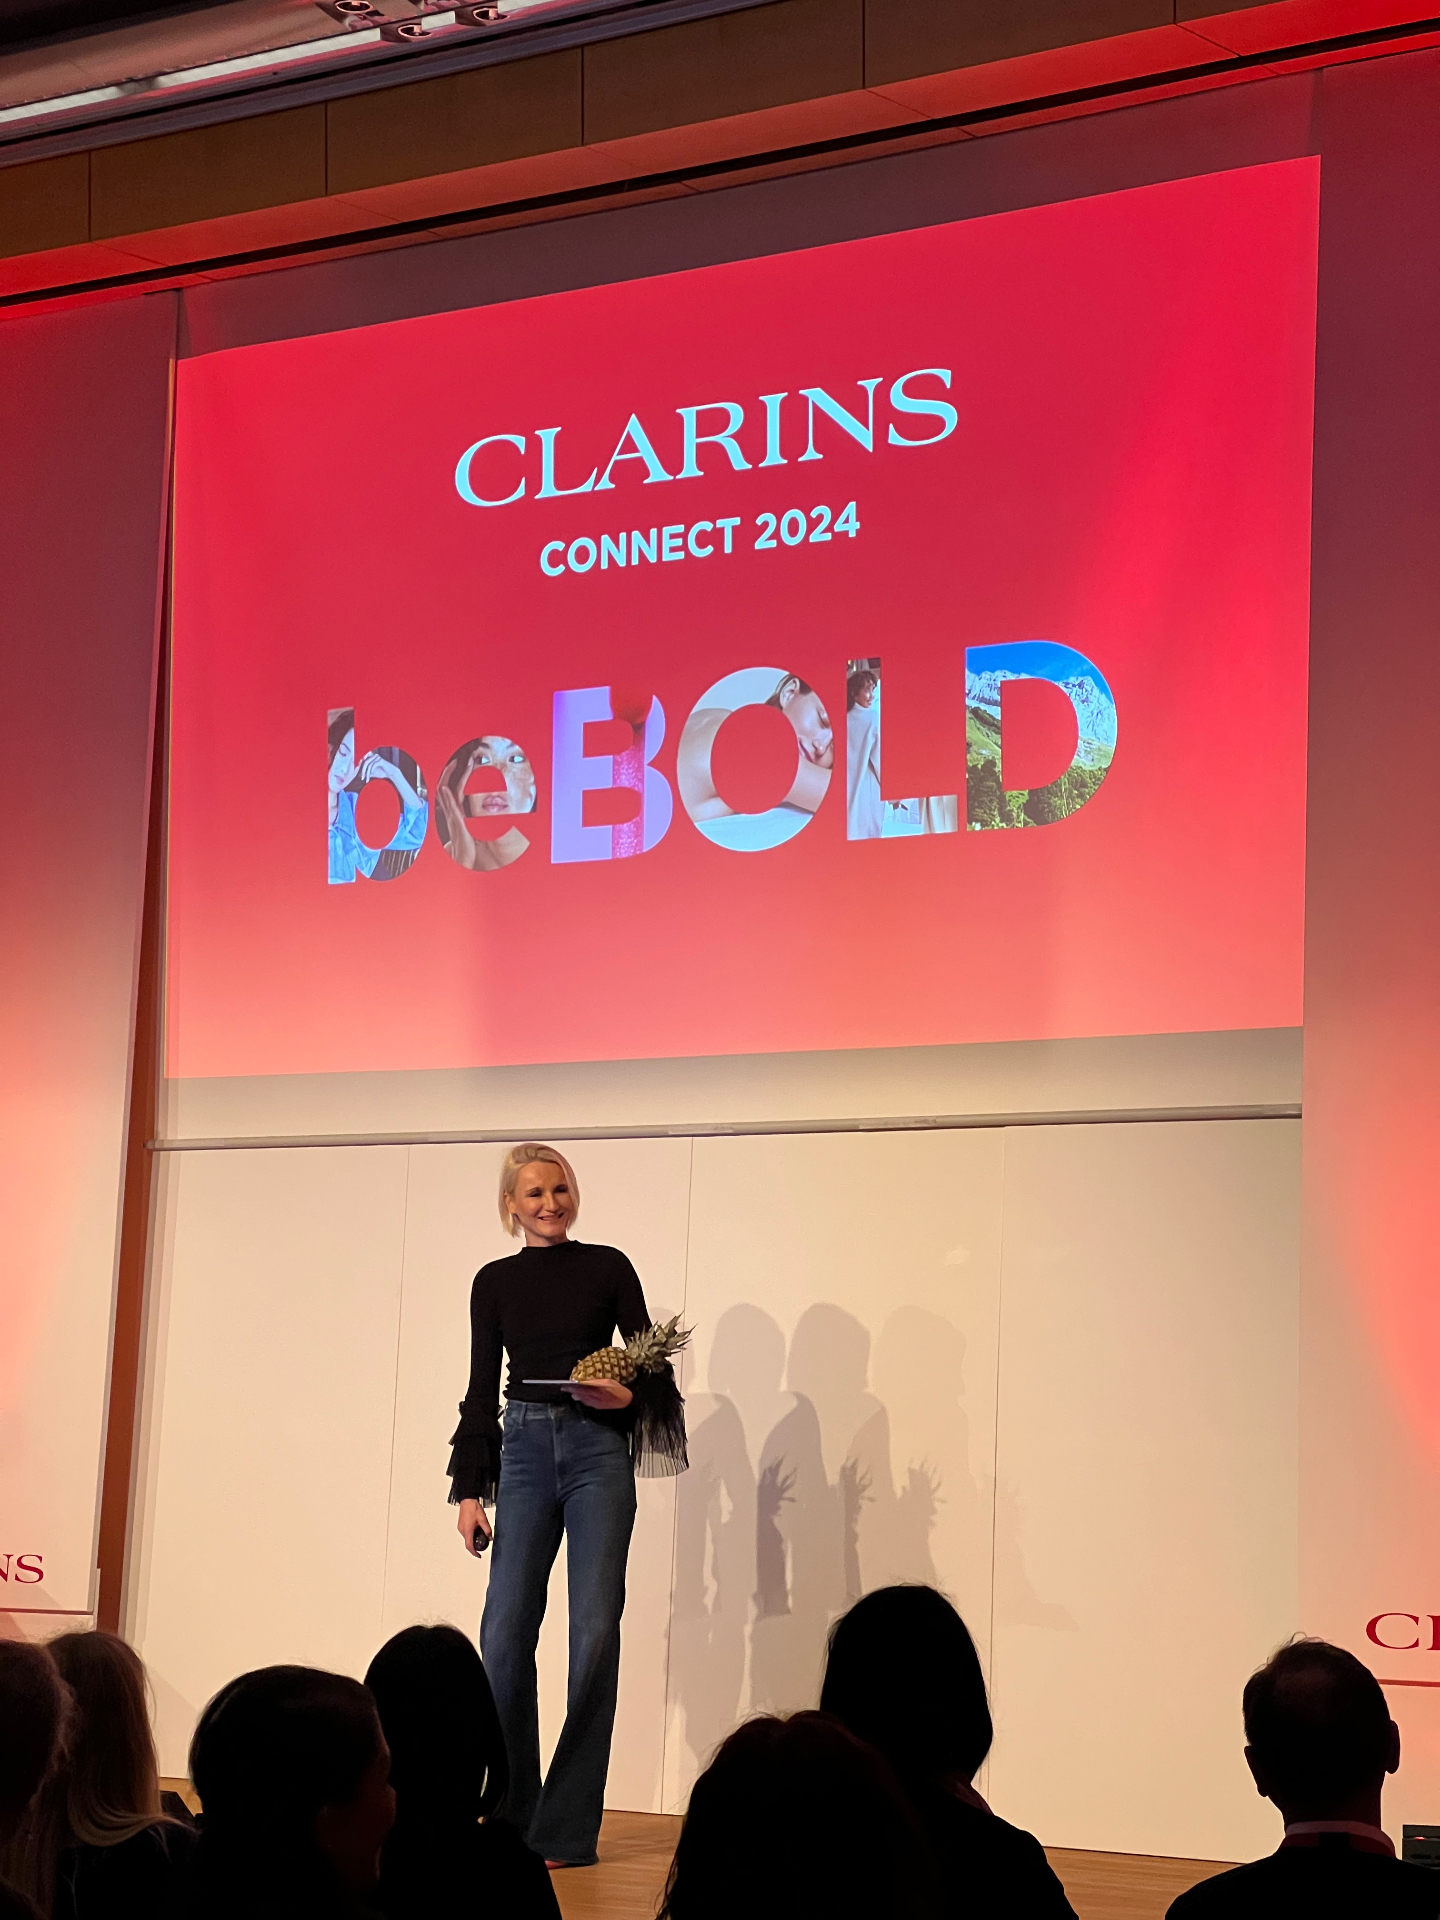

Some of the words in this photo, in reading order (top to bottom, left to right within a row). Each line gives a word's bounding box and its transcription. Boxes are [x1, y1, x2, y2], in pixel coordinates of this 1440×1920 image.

[454, 368, 958, 507] CLARINS
[540, 515, 741, 576] CONNECT
[754, 501, 860, 550] 2024
